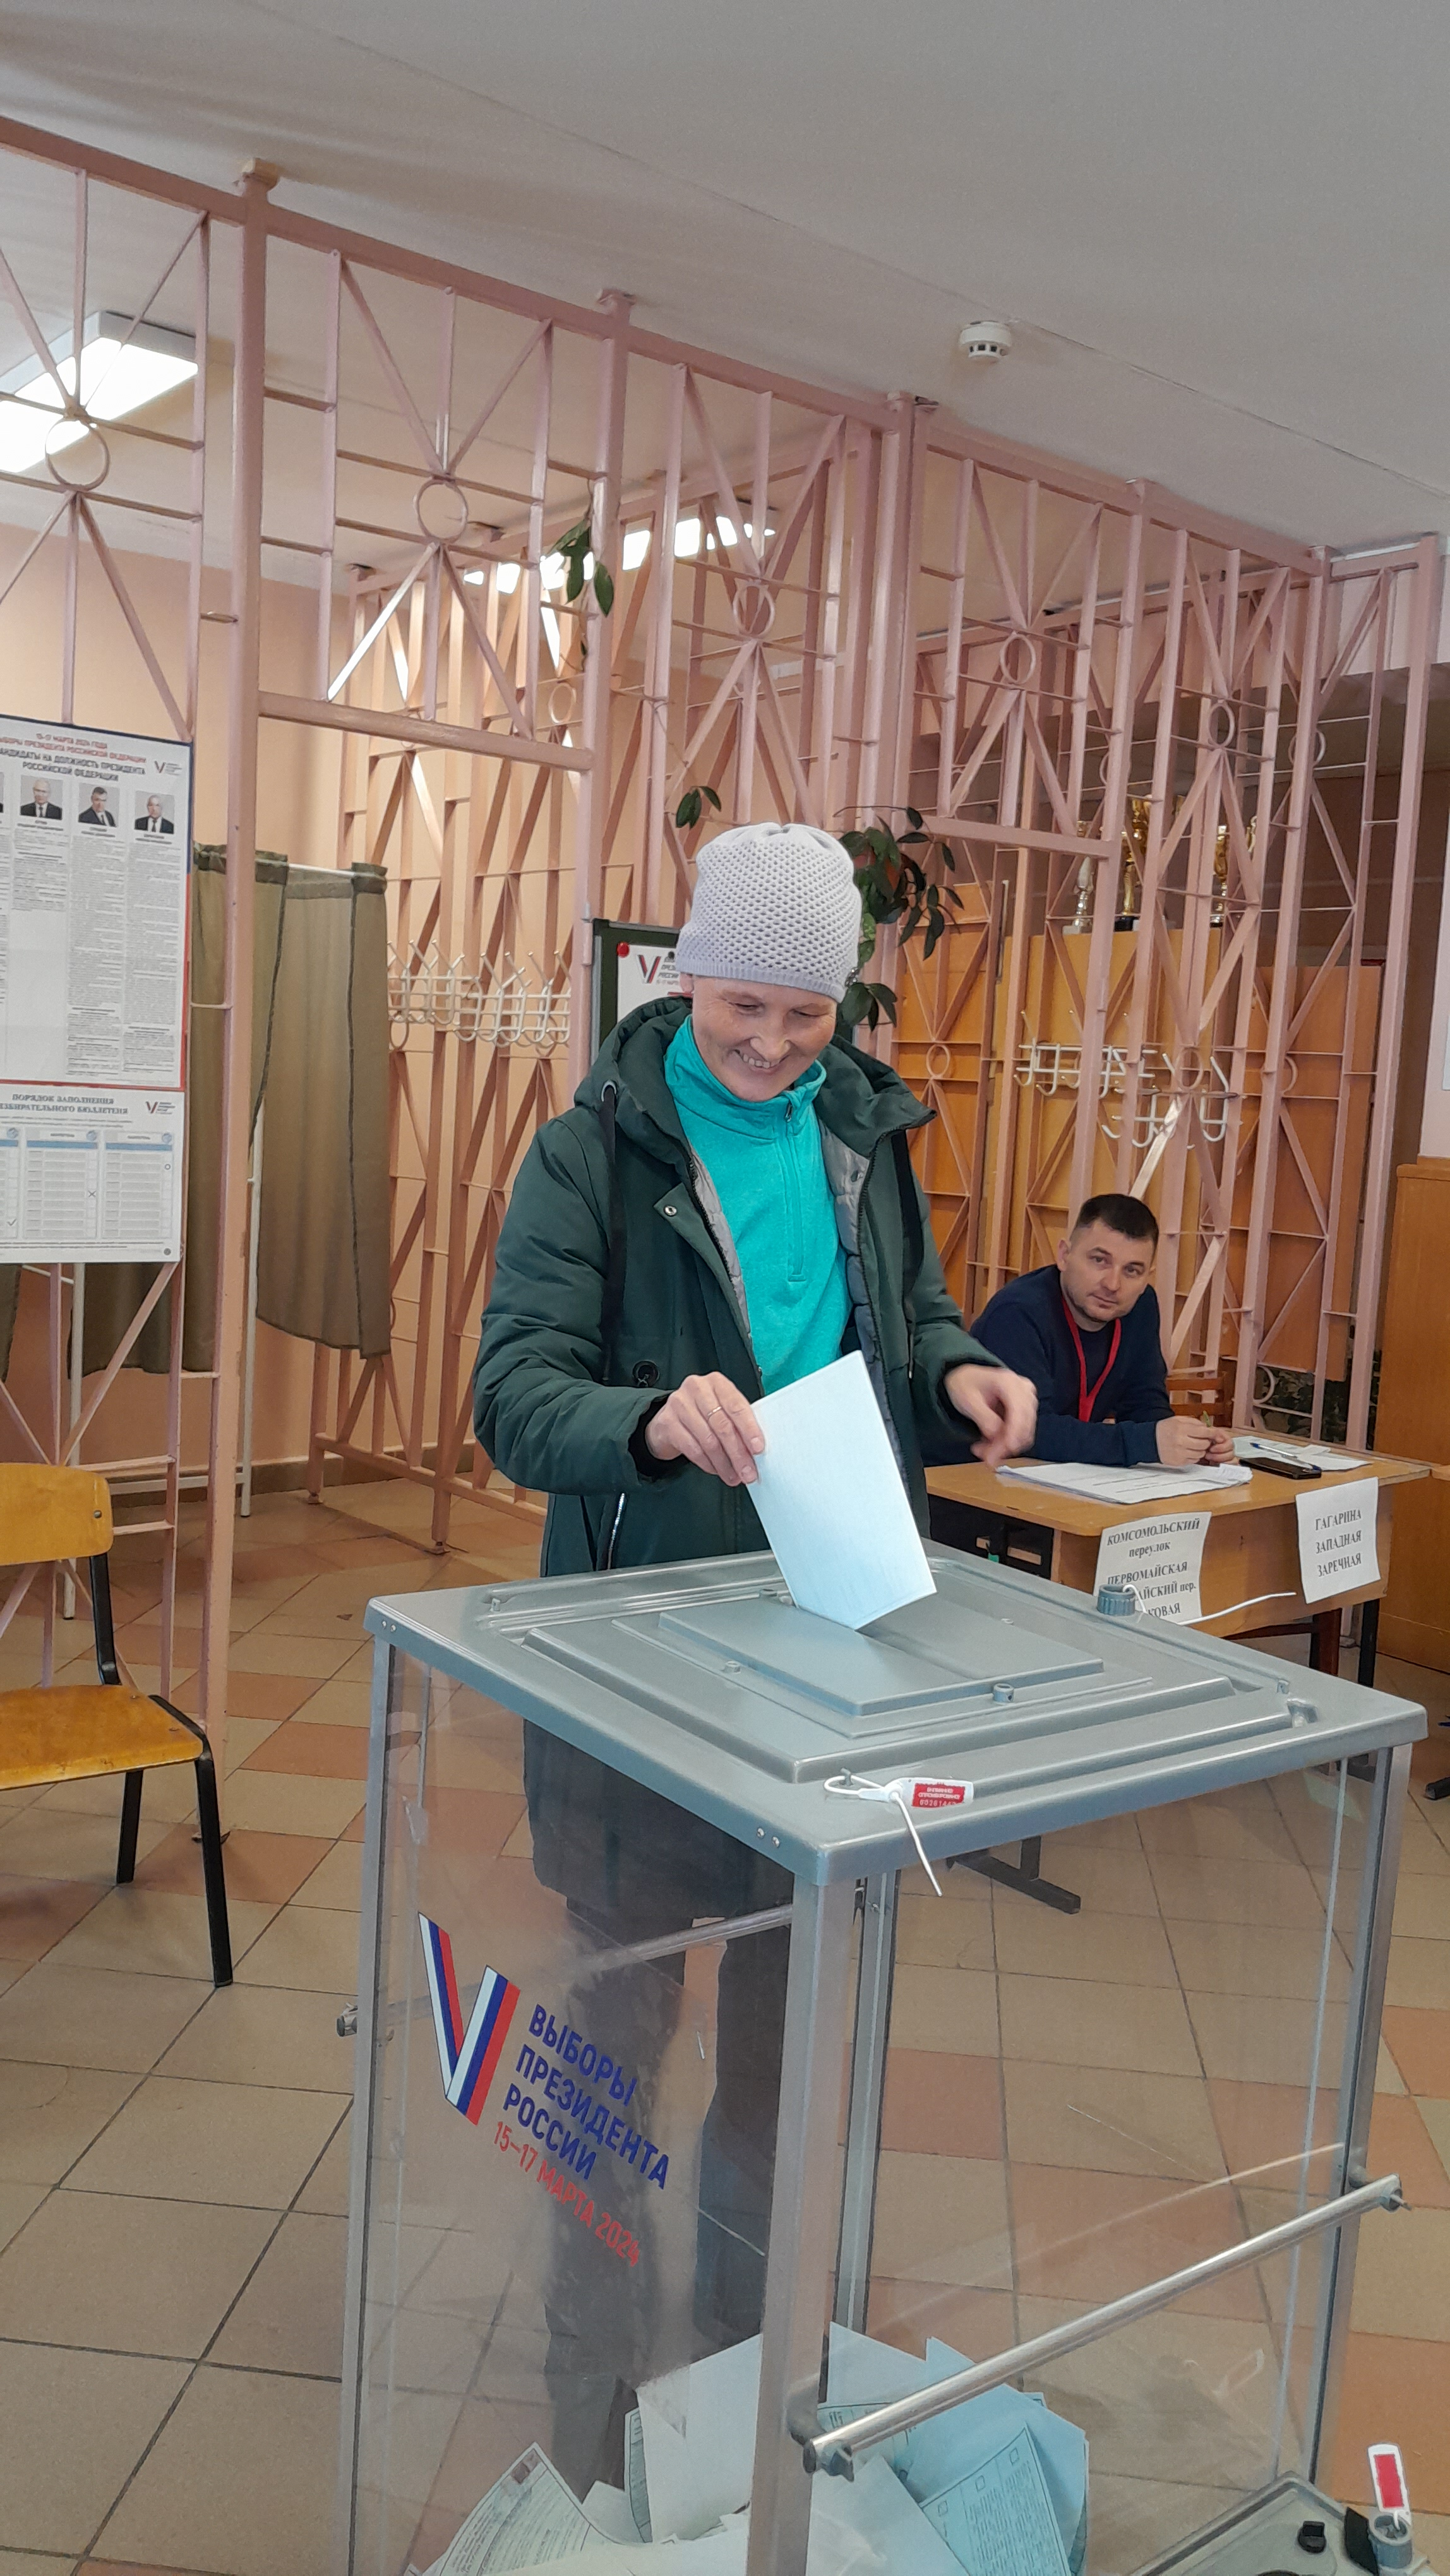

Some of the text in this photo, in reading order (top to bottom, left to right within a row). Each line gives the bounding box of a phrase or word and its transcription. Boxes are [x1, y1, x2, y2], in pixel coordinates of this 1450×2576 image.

[1106, 1518, 1201, 1546] КОМСОМОЛЬСКИЙ
[1315, 1509, 1362, 1531] ГАГАРИНА
[1129, 1542, 1171, 1558] переулок
[1315, 1530, 1362, 1554] ЗАПАДНАЯ
[1107, 1561, 1187, 1585] ПЕРВОМАЙСКАЯ
[1318, 1553, 1362, 1577] ЗАРЕЧНАЯ
[1180, 1582, 1196, 1592] пер.
[528, 2003, 637, 2107] ВЫБОРЫ
[515, 2044, 670, 2190] ПРЕЗИДЕНТА
[503, 2083, 597, 2182] РОССИИ
[536, 2159, 595, 2227] МАРТА
[595, 2212, 641, 2267] 2024
